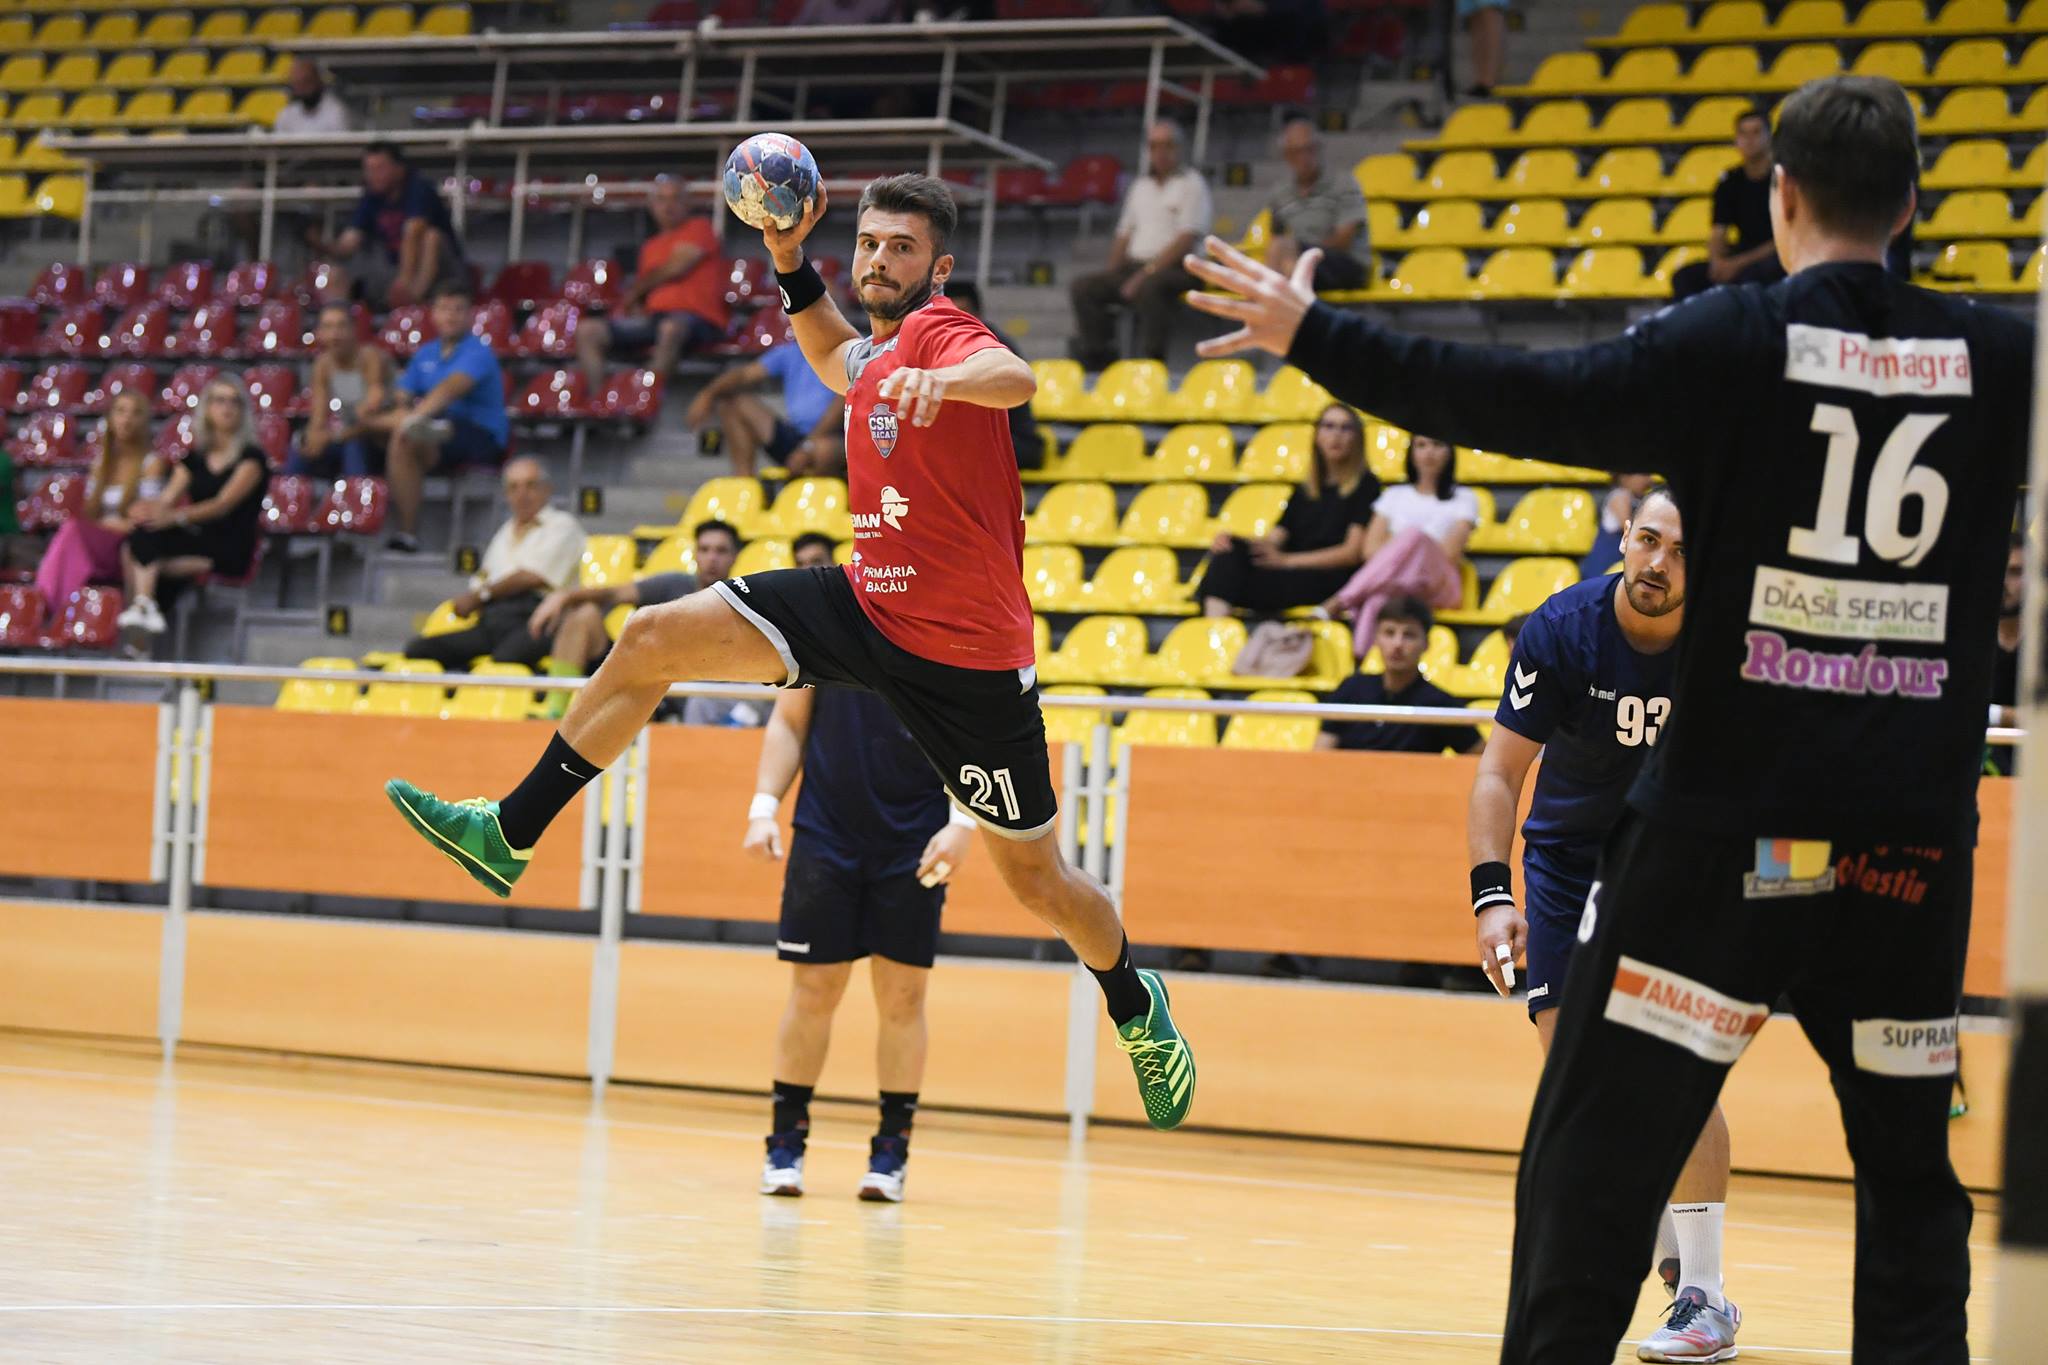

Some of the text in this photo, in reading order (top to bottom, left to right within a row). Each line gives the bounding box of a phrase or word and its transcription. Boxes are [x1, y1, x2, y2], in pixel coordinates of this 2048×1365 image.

[1838, 337, 1969, 390] Prmagra
[869, 416, 897, 431] CSM
[1786, 402, 1951, 569] 16
[862, 564, 917, 580] PRMĂRIA
[865, 579, 908, 593] BACĂU
[1615, 695, 1672, 747] 93
[960, 764, 1021, 821] 21
[1646, 978, 1743, 1036] ANASPED
